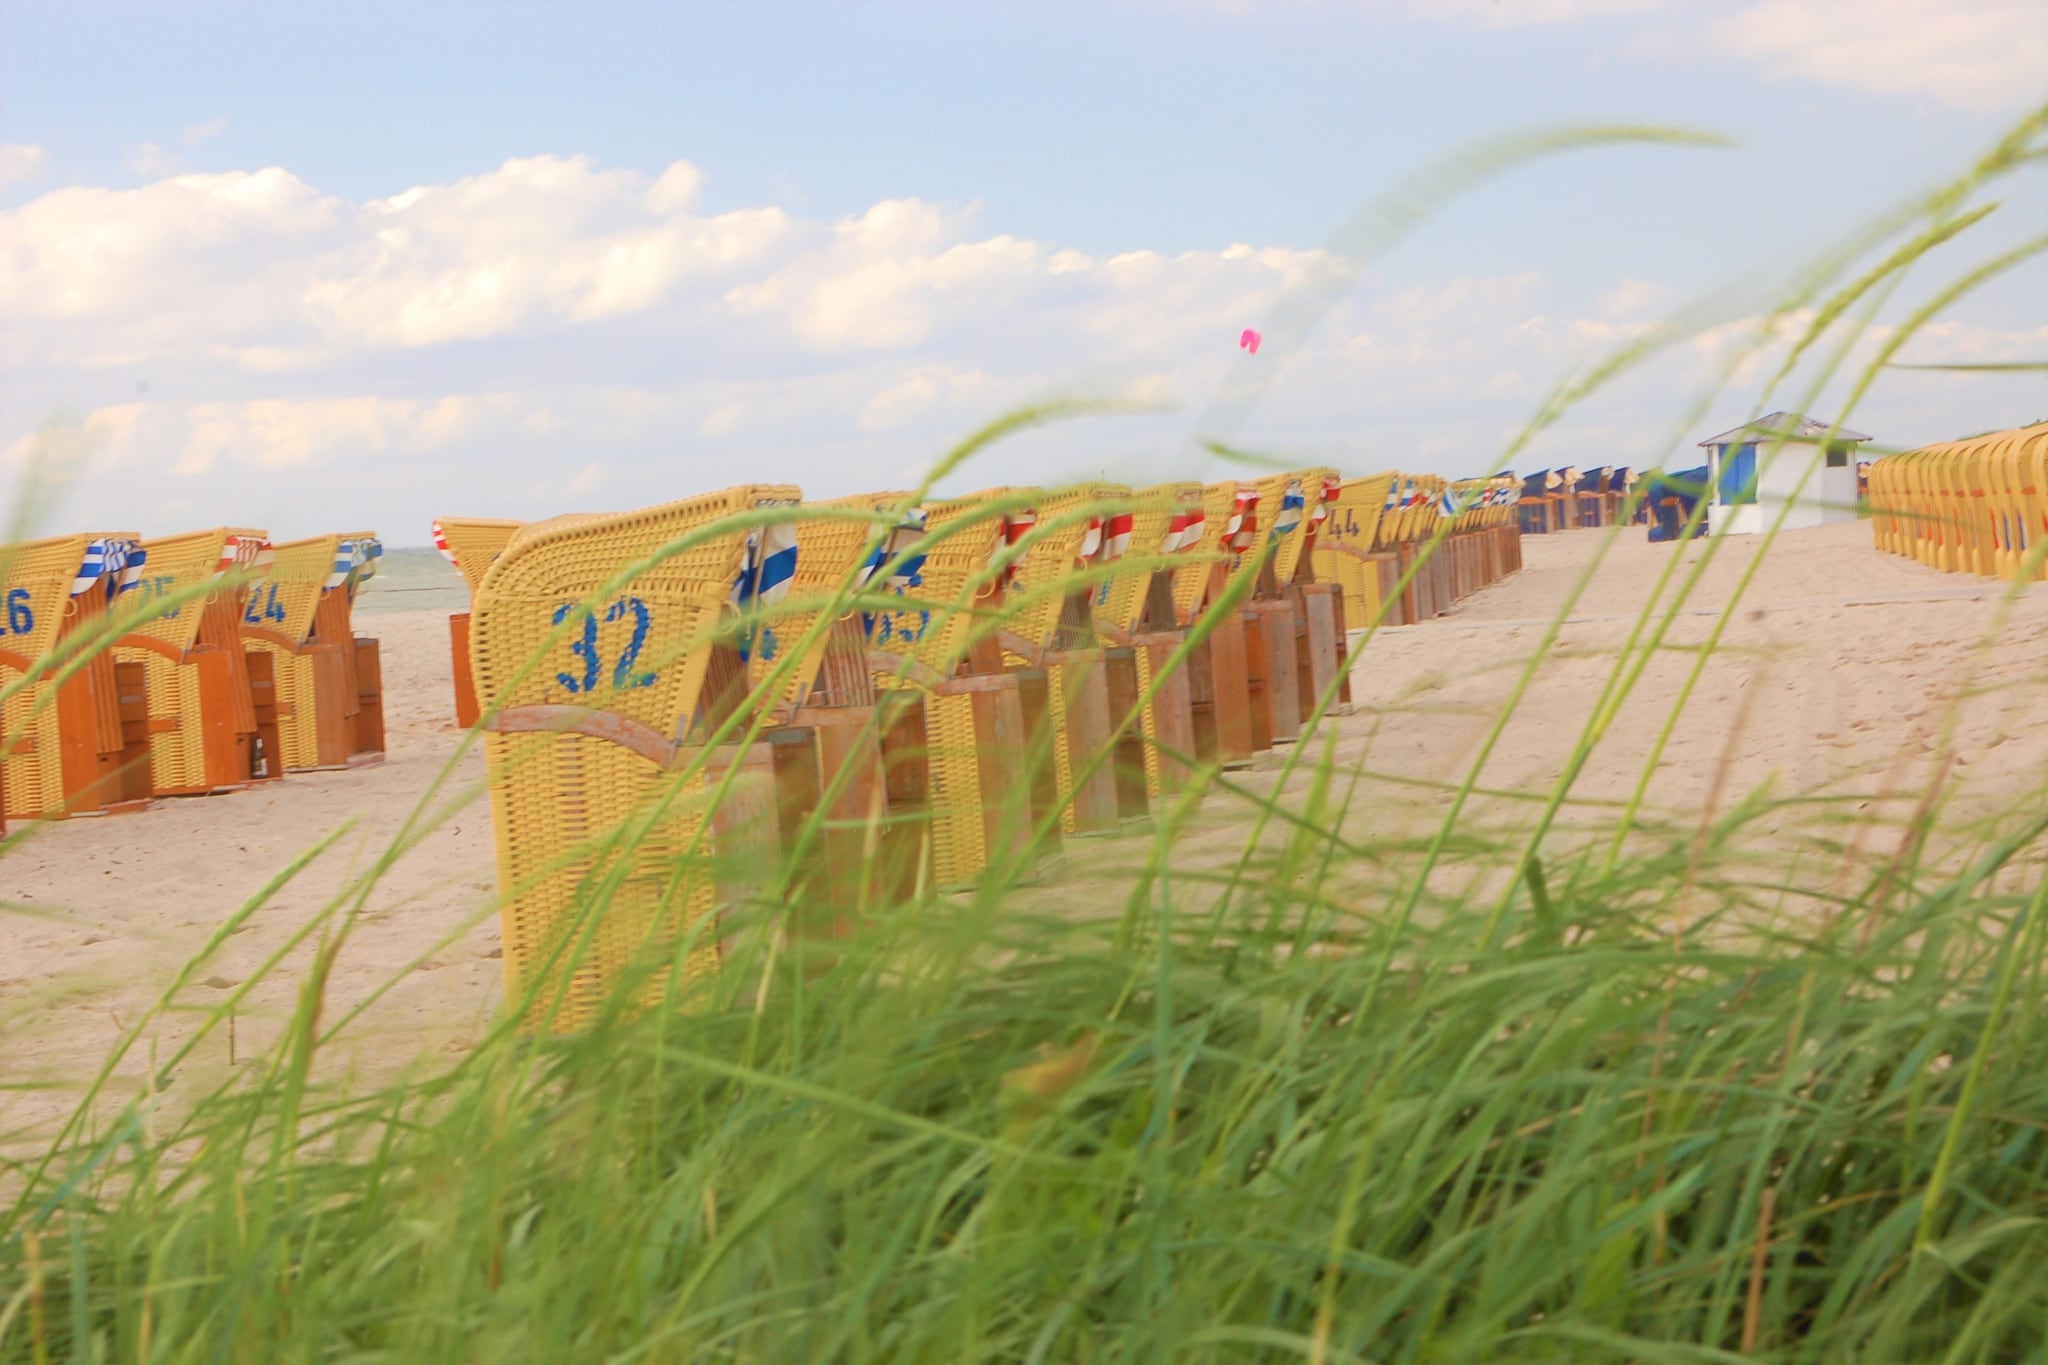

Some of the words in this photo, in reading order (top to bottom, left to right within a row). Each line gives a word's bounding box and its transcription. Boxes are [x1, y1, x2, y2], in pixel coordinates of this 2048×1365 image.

[1329, 508, 1359, 539] 44
[0, 588, 33, 634] 6
[244, 583, 285, 623] 24
[552, 596, 657, 692] 32
